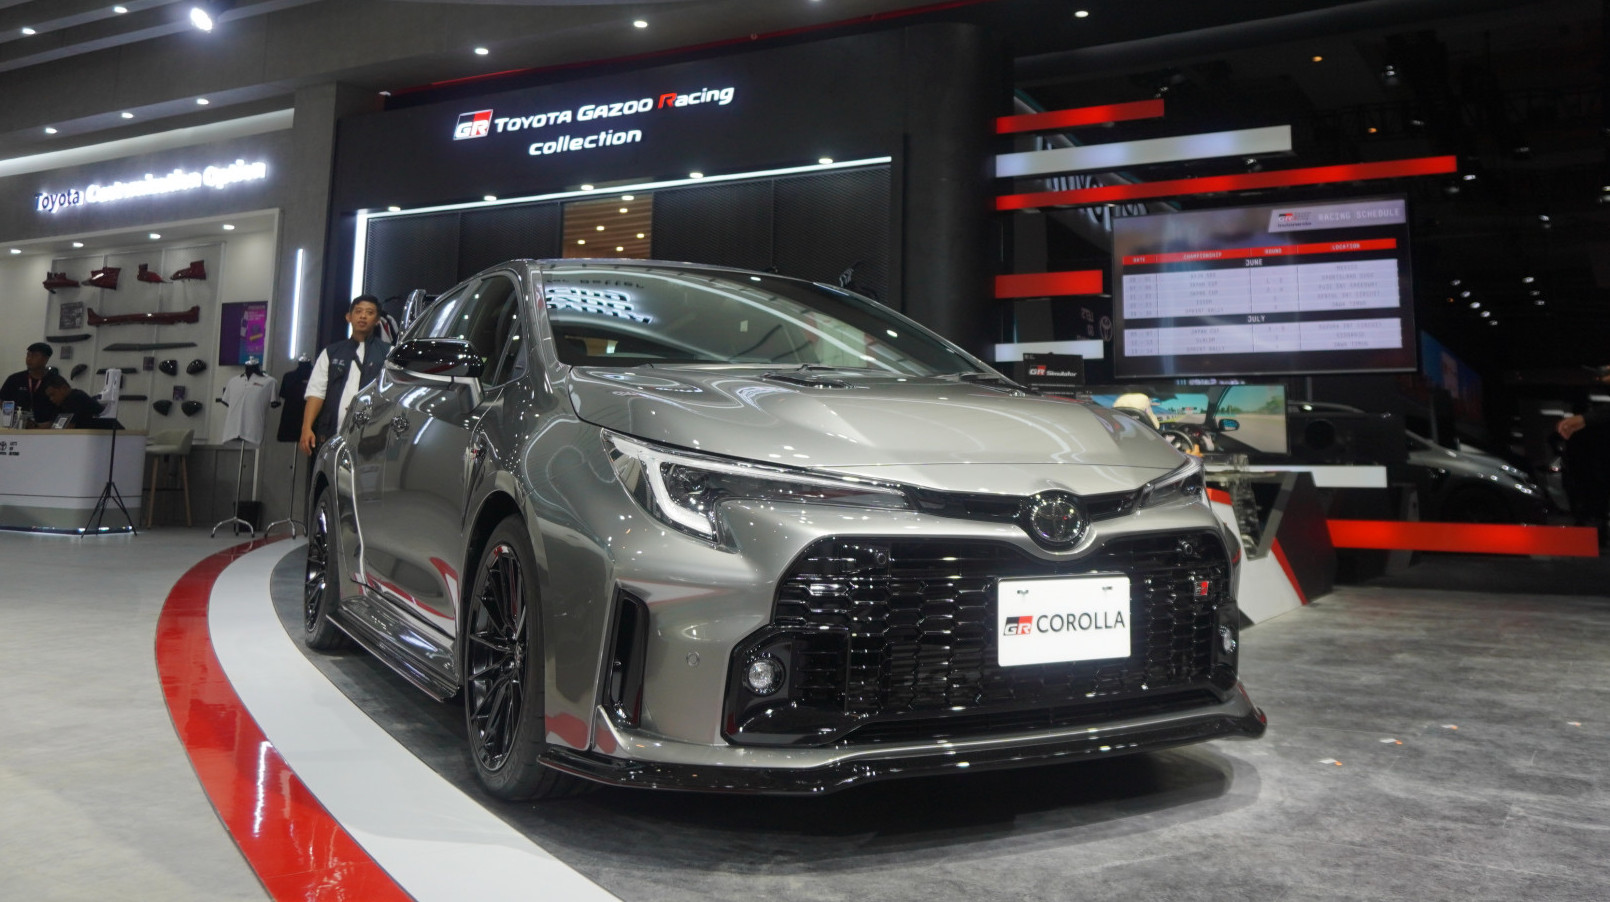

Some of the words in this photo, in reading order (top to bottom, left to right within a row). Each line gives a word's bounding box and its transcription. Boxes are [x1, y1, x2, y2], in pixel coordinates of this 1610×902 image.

[454, 117, 491, 139] GR
[494, 110, 572, 133] TOYOTA
[577, 98, 653, 121] GAZOO
[658, 87, 735, 109] Racing
[529, 129, 642, 156] collection
[36, 189, 83, 213] Toyota
[1318, 212, 1351, 221] RACING
[1357, 208, 1400, 219] SCHEDULE
[1245, 258, 1263, 266] JUNE
[1248, 315, 1266, 323] JULY
[1004, 620, 1033, 636] GR
[1036, 610, 1126, 633] COROLLA
